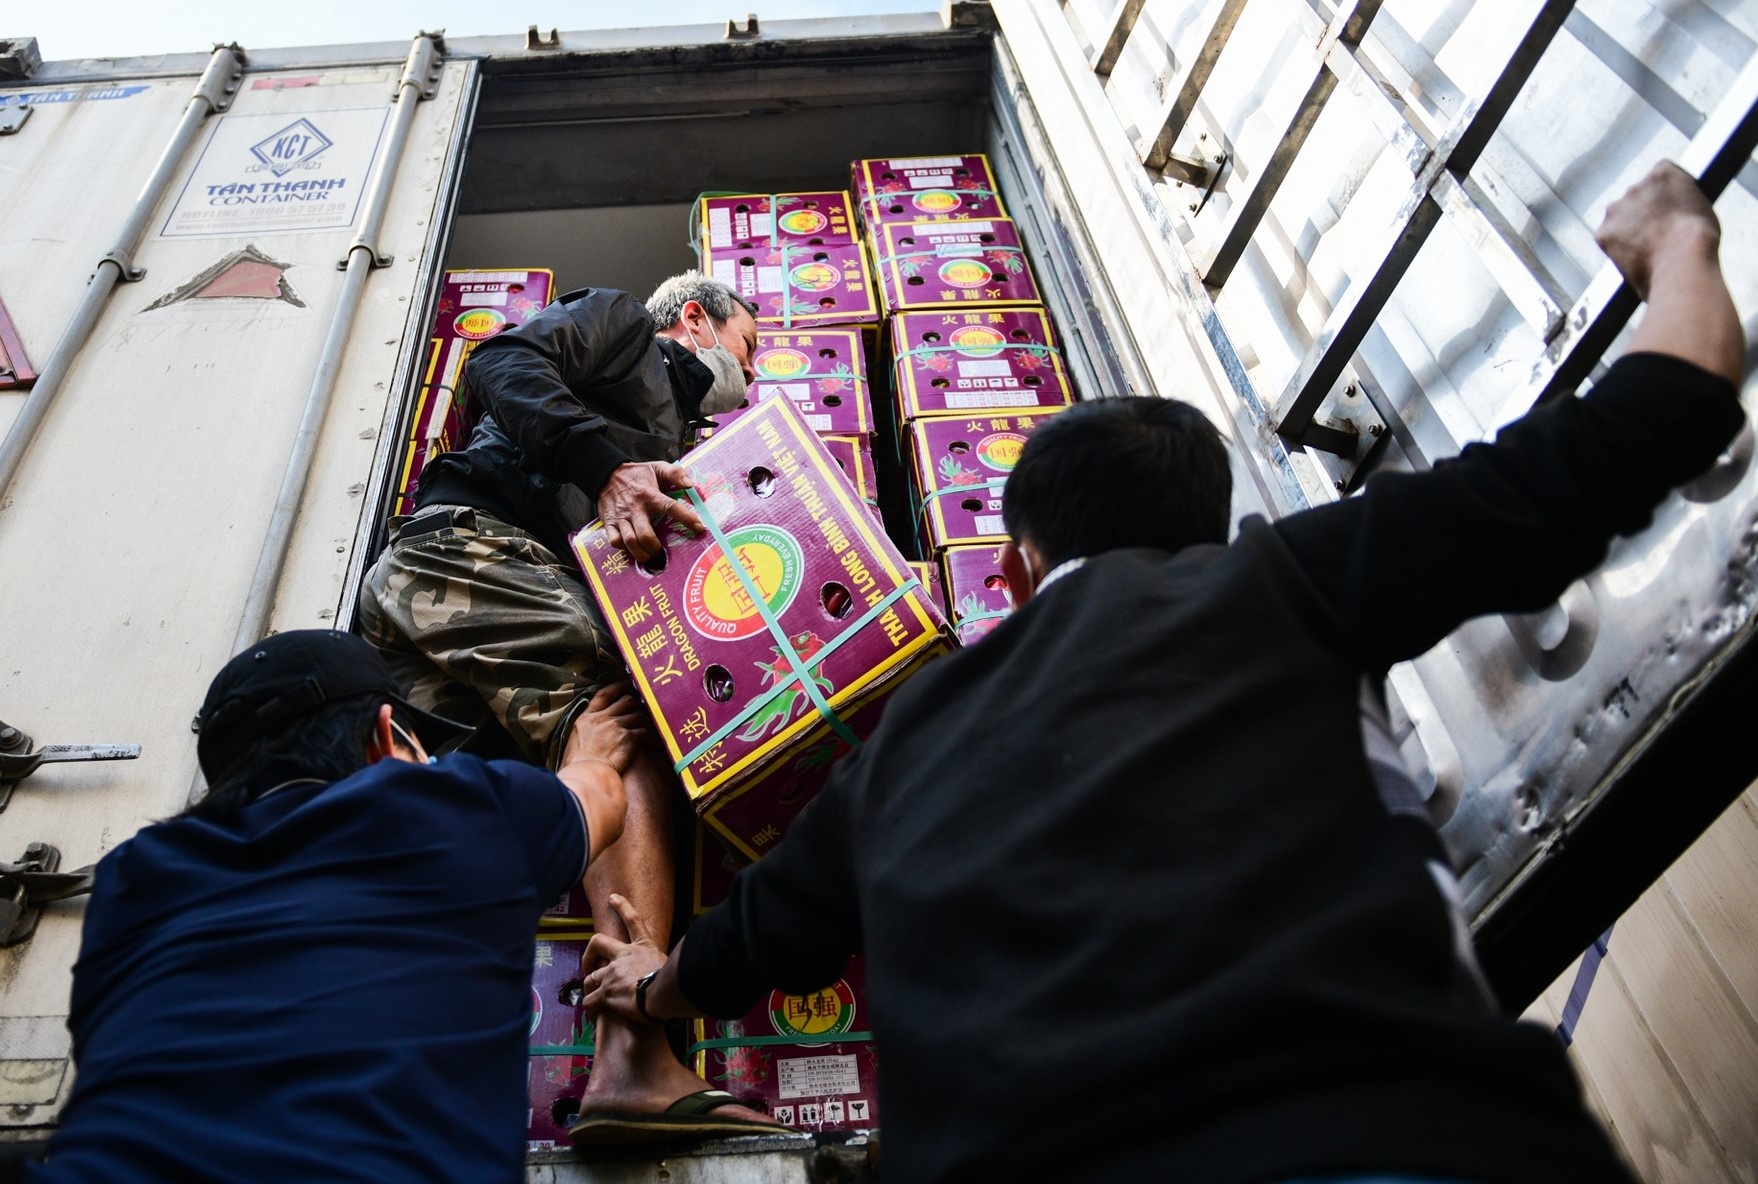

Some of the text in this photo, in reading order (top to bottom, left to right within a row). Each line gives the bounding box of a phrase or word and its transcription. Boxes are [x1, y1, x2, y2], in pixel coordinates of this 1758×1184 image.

[271, 134, 312, 160] KCT
[206, 178, 346, 197] TÂN THANH
[209, 191, 329, 206] CONTAINER
[942, 313, 1005, 325] 火龍果
[967, 417, 1035, 432] 火龍果
[755, 418, 909, 647] THAH LONG BÌNH THUẬN VIỆT NAM
[751, 534, 794, 592] FRESH EVERYDAY
[690, 566, 737, 634] QUALITY FRUIT
[621, 595, 684, 686] 火龍果
[649, 583, 701, 672] DRAGON FRUIT
[554, 905, 565, 913] 42
